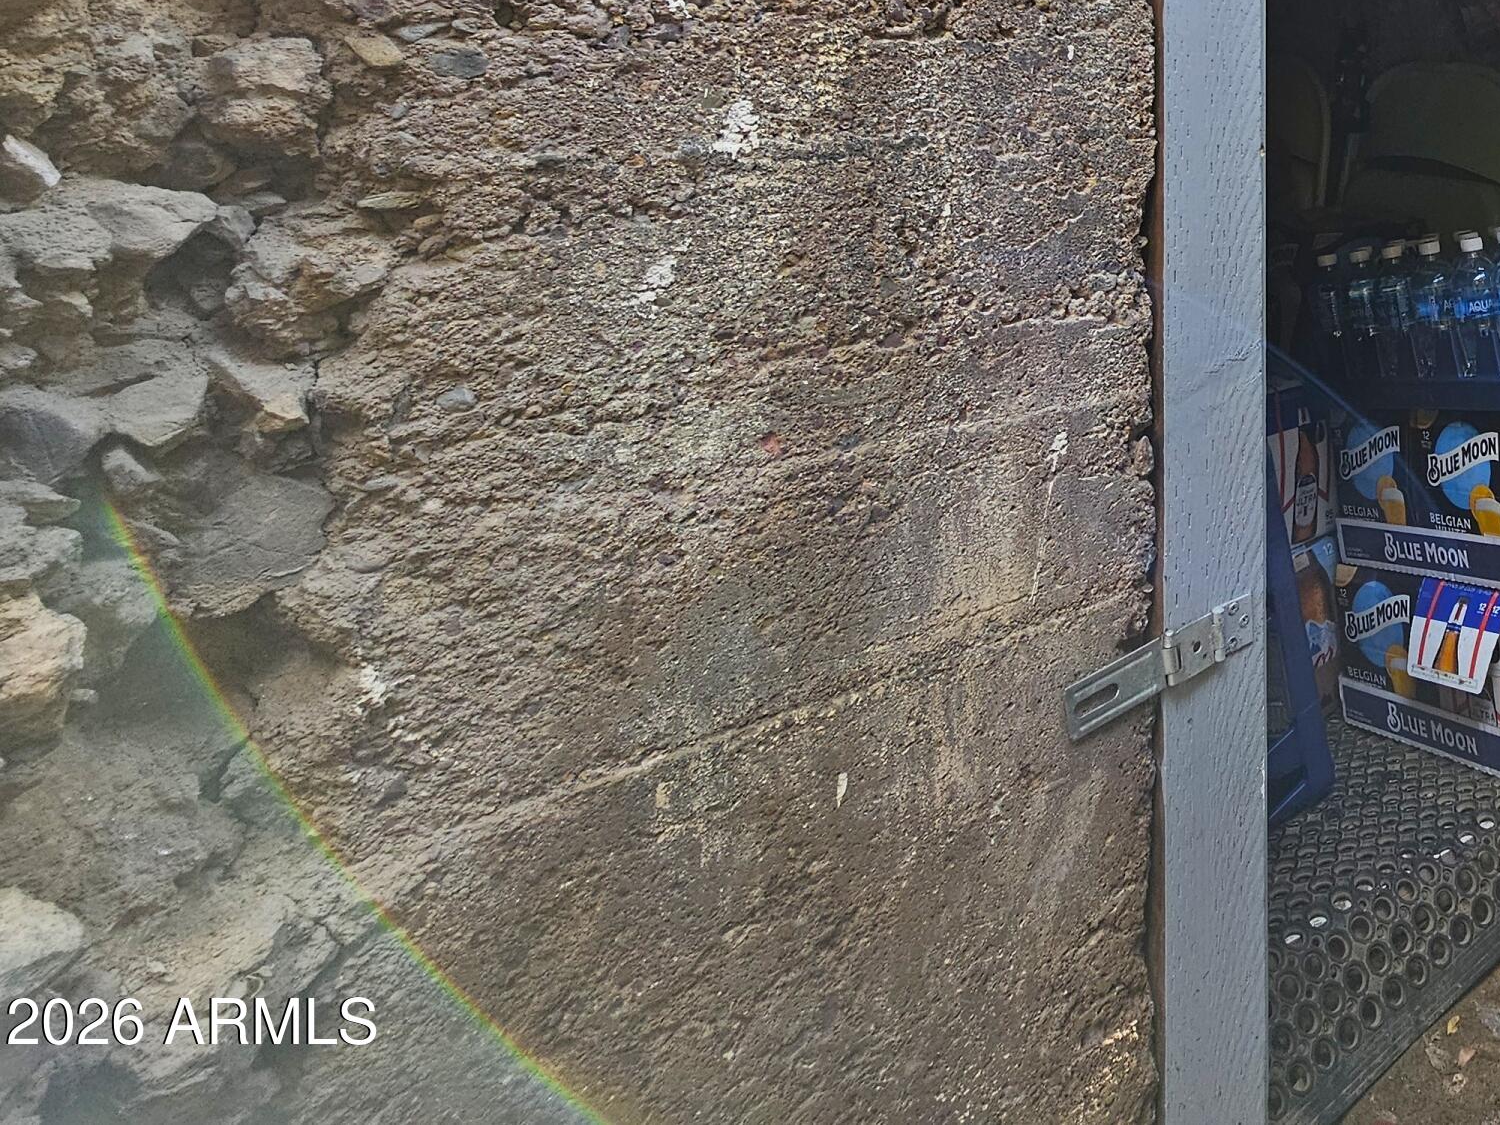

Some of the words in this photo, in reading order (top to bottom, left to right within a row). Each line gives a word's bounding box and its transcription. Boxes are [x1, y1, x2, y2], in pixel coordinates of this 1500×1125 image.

[1468, 298, 1493, 313] AQUA
[1341, 448, 1369, 477] BLUE
[1368, 430, 1399, 460] MOON
[1427, 452, 1460, 484] BLUE
[1460, 437, 1497, 467] MOON
[1343, 505, 1380, 519] BELGIAN
[1429, 512, 1472, 530] BELGIAN
[1322, 542, 1334, 555] 12
[1384, 532, 1423, 563] BLUE
[1424, 542, 1470, 570] MOON
[1478, 602, 1487, 612] 12
[1346, 610, 1376, 641] BLUE
[1376, 599, 1409, 626] MOON
[1347, 666, 1387, 686] BELGIAN
[1386, 702, 1428, 738] BLUE
[1430, 720, 1479, 756] MOON
